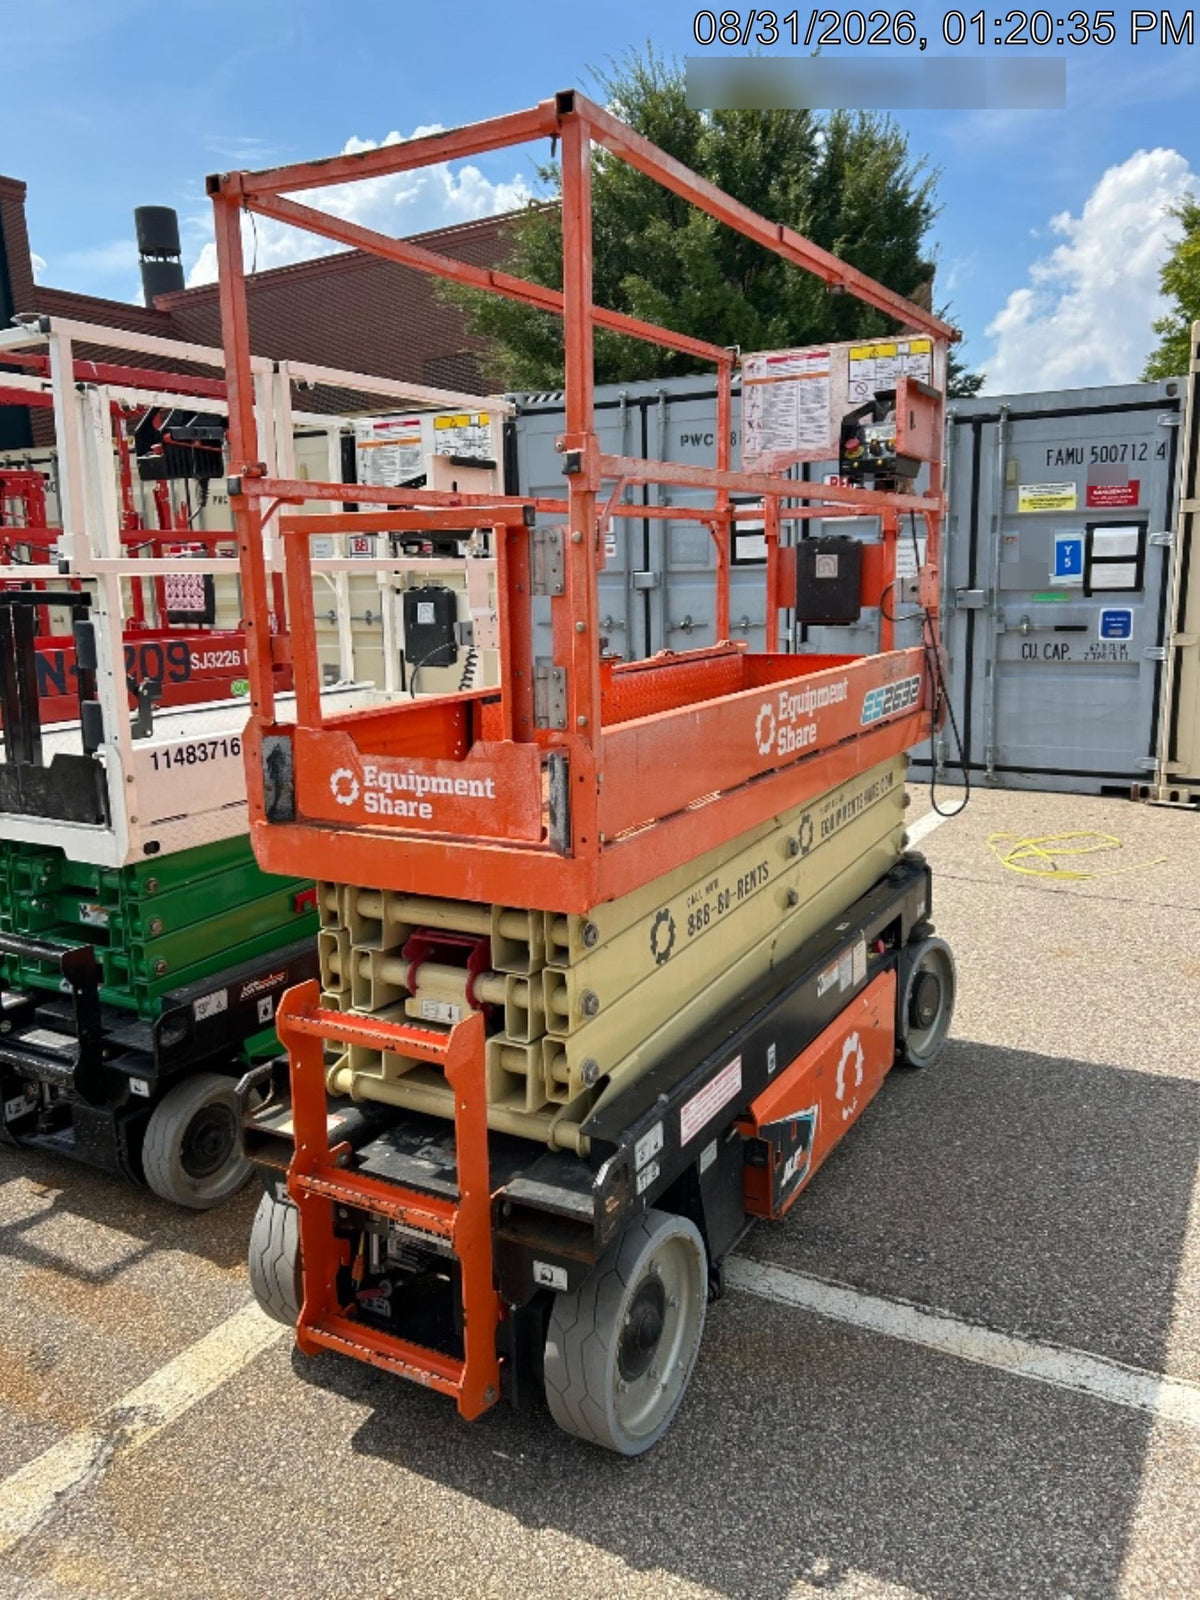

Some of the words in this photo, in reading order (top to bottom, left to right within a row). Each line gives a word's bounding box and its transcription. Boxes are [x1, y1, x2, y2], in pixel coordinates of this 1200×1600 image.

[1046, 446, 1084, 467] FAMU
[1090, 442, 1148, 465] 500712
[1156, 440, 1167, 461] 4
[189, 649, 241, 670] SJ3226
[1043, 643, 1072, 661] CAP.
[778, 678, 849, 723] Equipment
[150, 736, 242, 771] 11483716
[776, 722, 818, 757] Share
[363, 765, 497, 800] Equipment
[363, 793, 434, 820] Share
[687, 859, 770, 938] 888-80-RENTS
